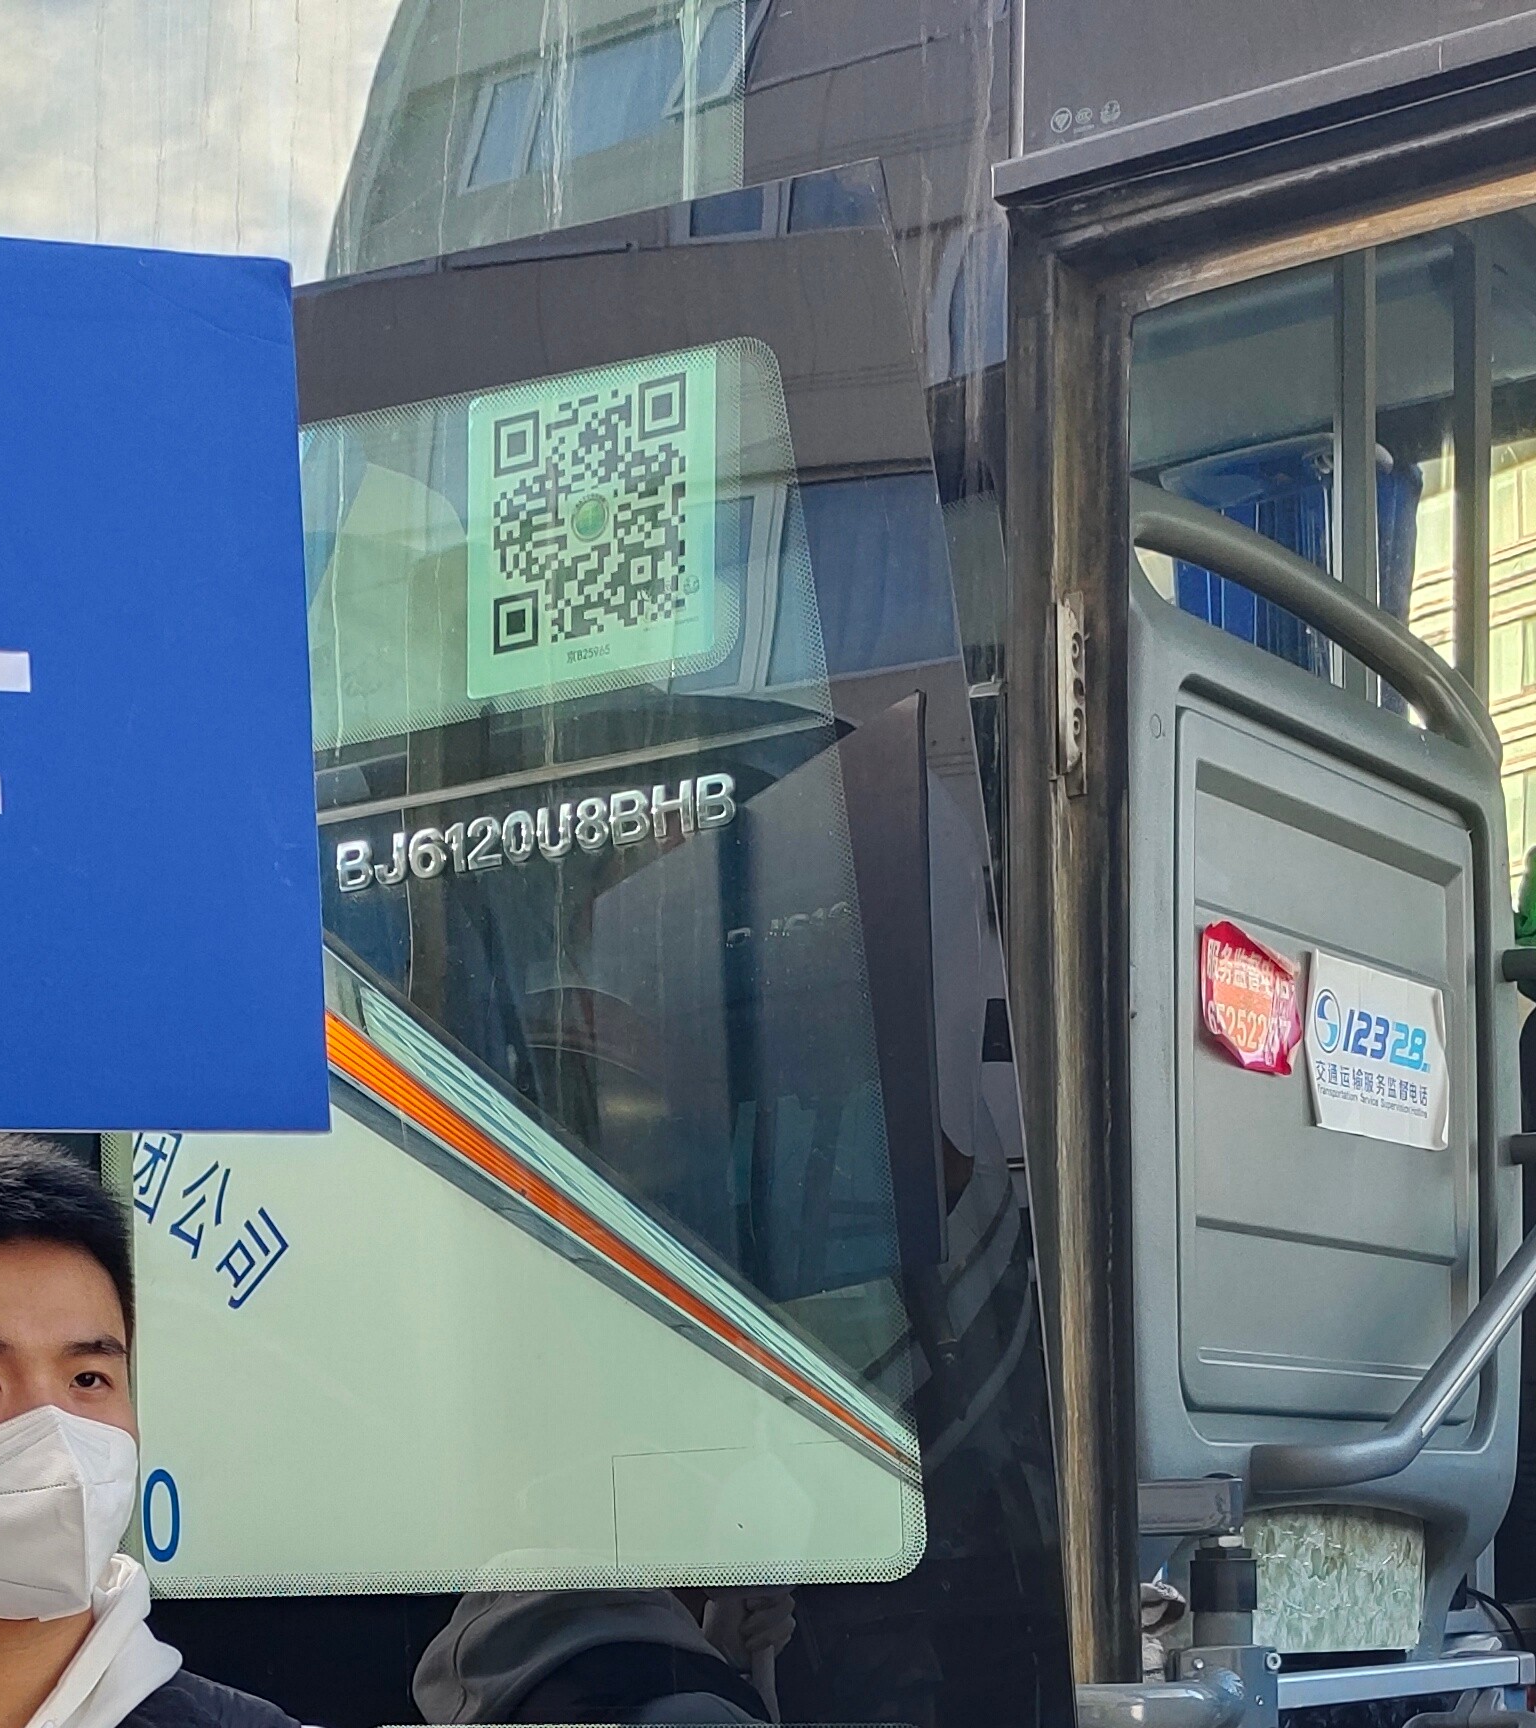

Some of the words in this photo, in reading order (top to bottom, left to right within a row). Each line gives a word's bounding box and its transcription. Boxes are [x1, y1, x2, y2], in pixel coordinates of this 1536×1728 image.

[335, 773, 737, 893] BJ6120U8BHB
[1343, 1008, 1428, 1072] 12328
[1315, 1059, 1429, 1107] 交通运输服务监督电话
[1317, 1083, 1358, 1102] Transportation
